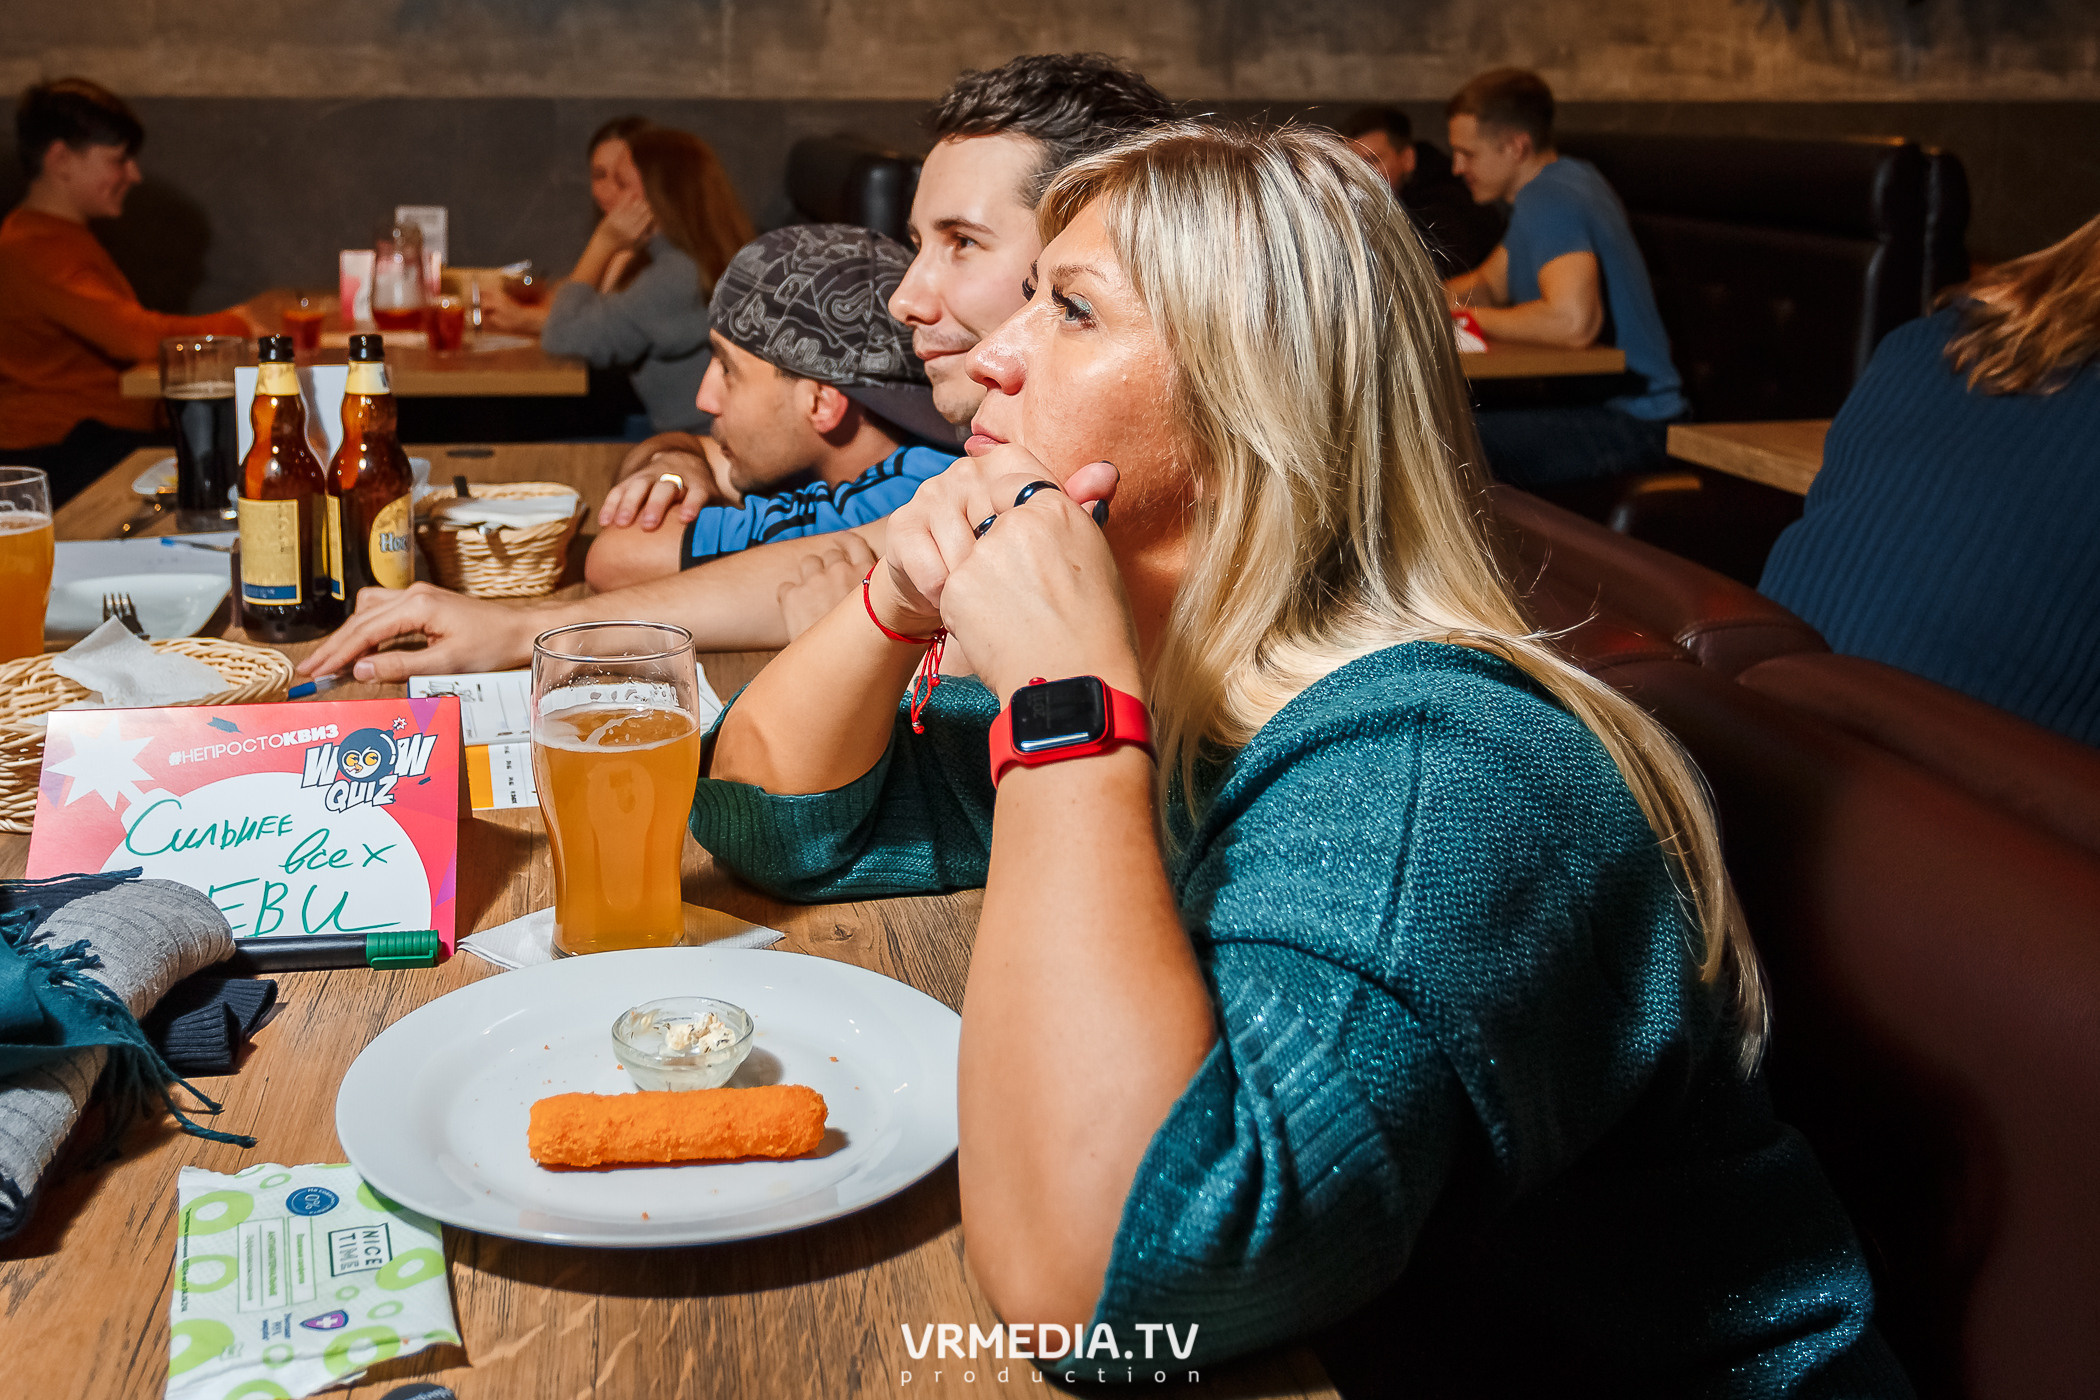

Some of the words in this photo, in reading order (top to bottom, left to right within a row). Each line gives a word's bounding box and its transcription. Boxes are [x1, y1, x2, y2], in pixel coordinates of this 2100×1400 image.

[168, 724, 340, 766] #НЕПРОСТОКВИЗ
[325, 774, 397, 814] QUIZ
[338, 1232, 359, 1271] TIME
[362, 1230, 382, 1266] NICE
